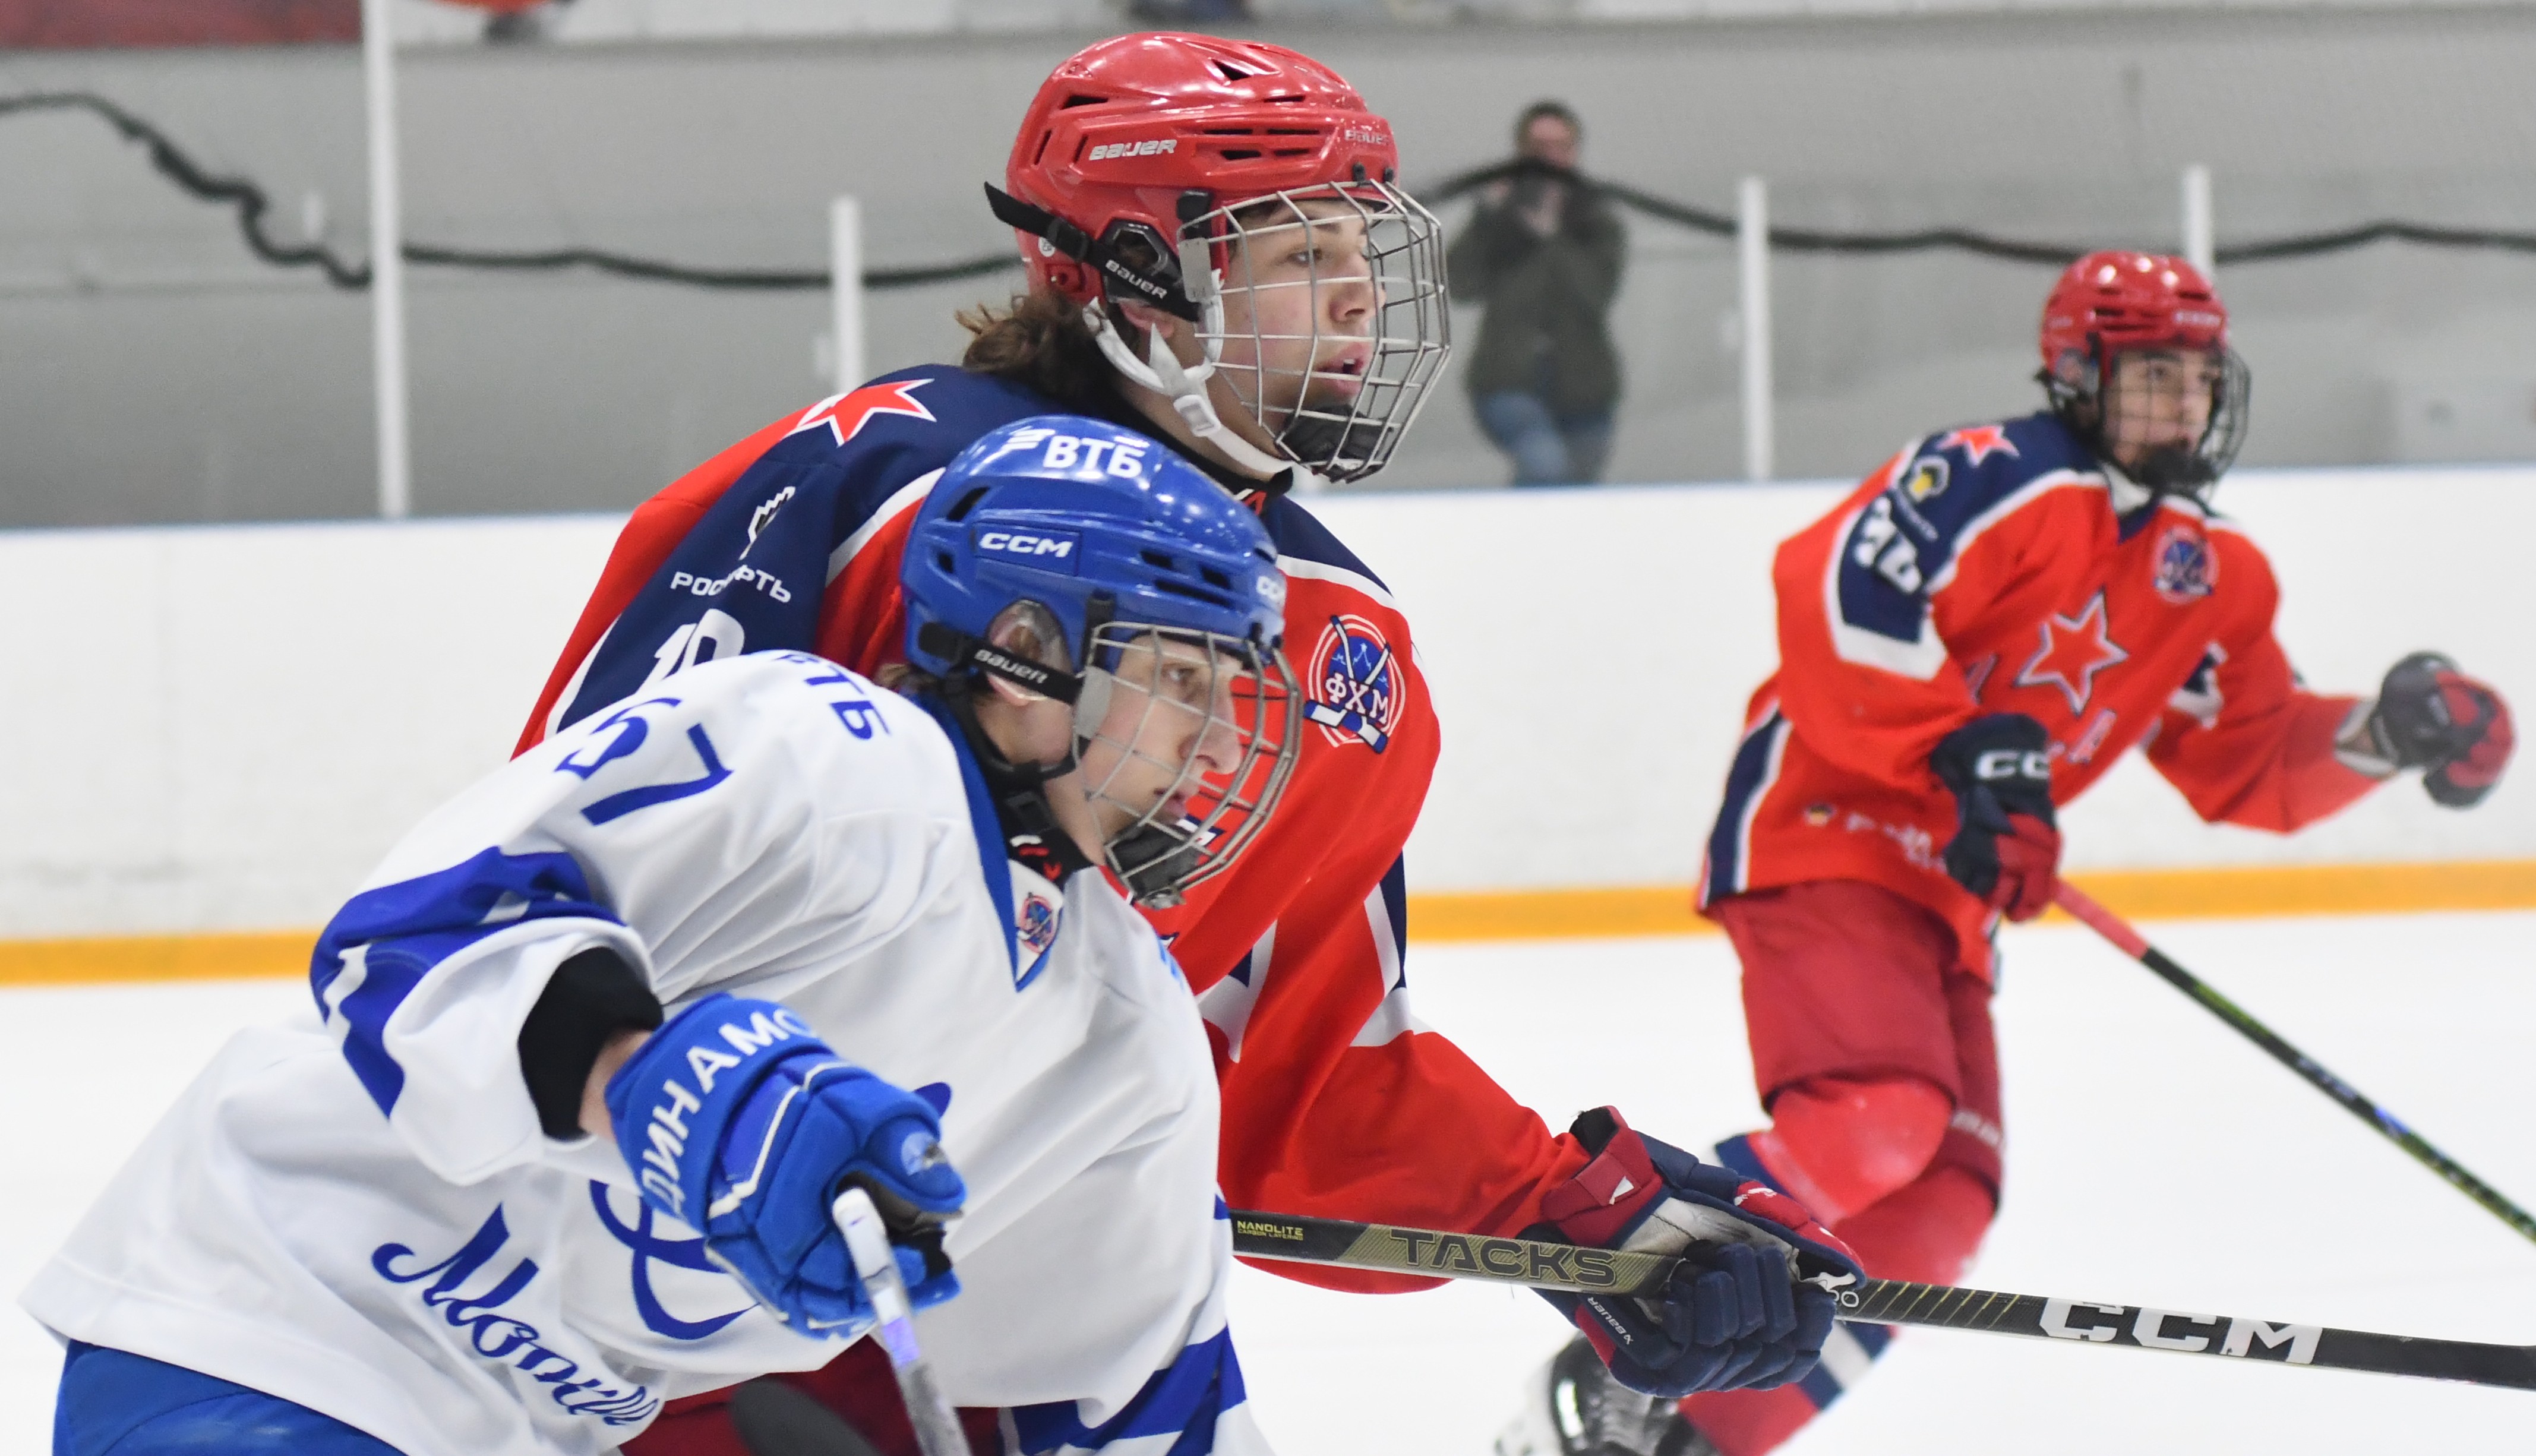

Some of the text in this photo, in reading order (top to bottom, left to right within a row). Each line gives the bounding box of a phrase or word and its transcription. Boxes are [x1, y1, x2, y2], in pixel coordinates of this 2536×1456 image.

[1089, 140, 1177, 161] BAUER
[1105, 260, 1167, 299] BAUER
[1043, 435, 1148, 479] ВТБ
[978, 532, 1074, 558] CCM
[974, 649, 1048, 684] BAUER
[1325, 672, 1389, 725] ФХМ
[1237, 1220, 1304, 1236] NANOLITE
[1389, 1228, 1616, 1286] TACKS
[1587, 1296, 1626, 1334] BAUER
[2039, 1297, 2323, 1365] CCM
